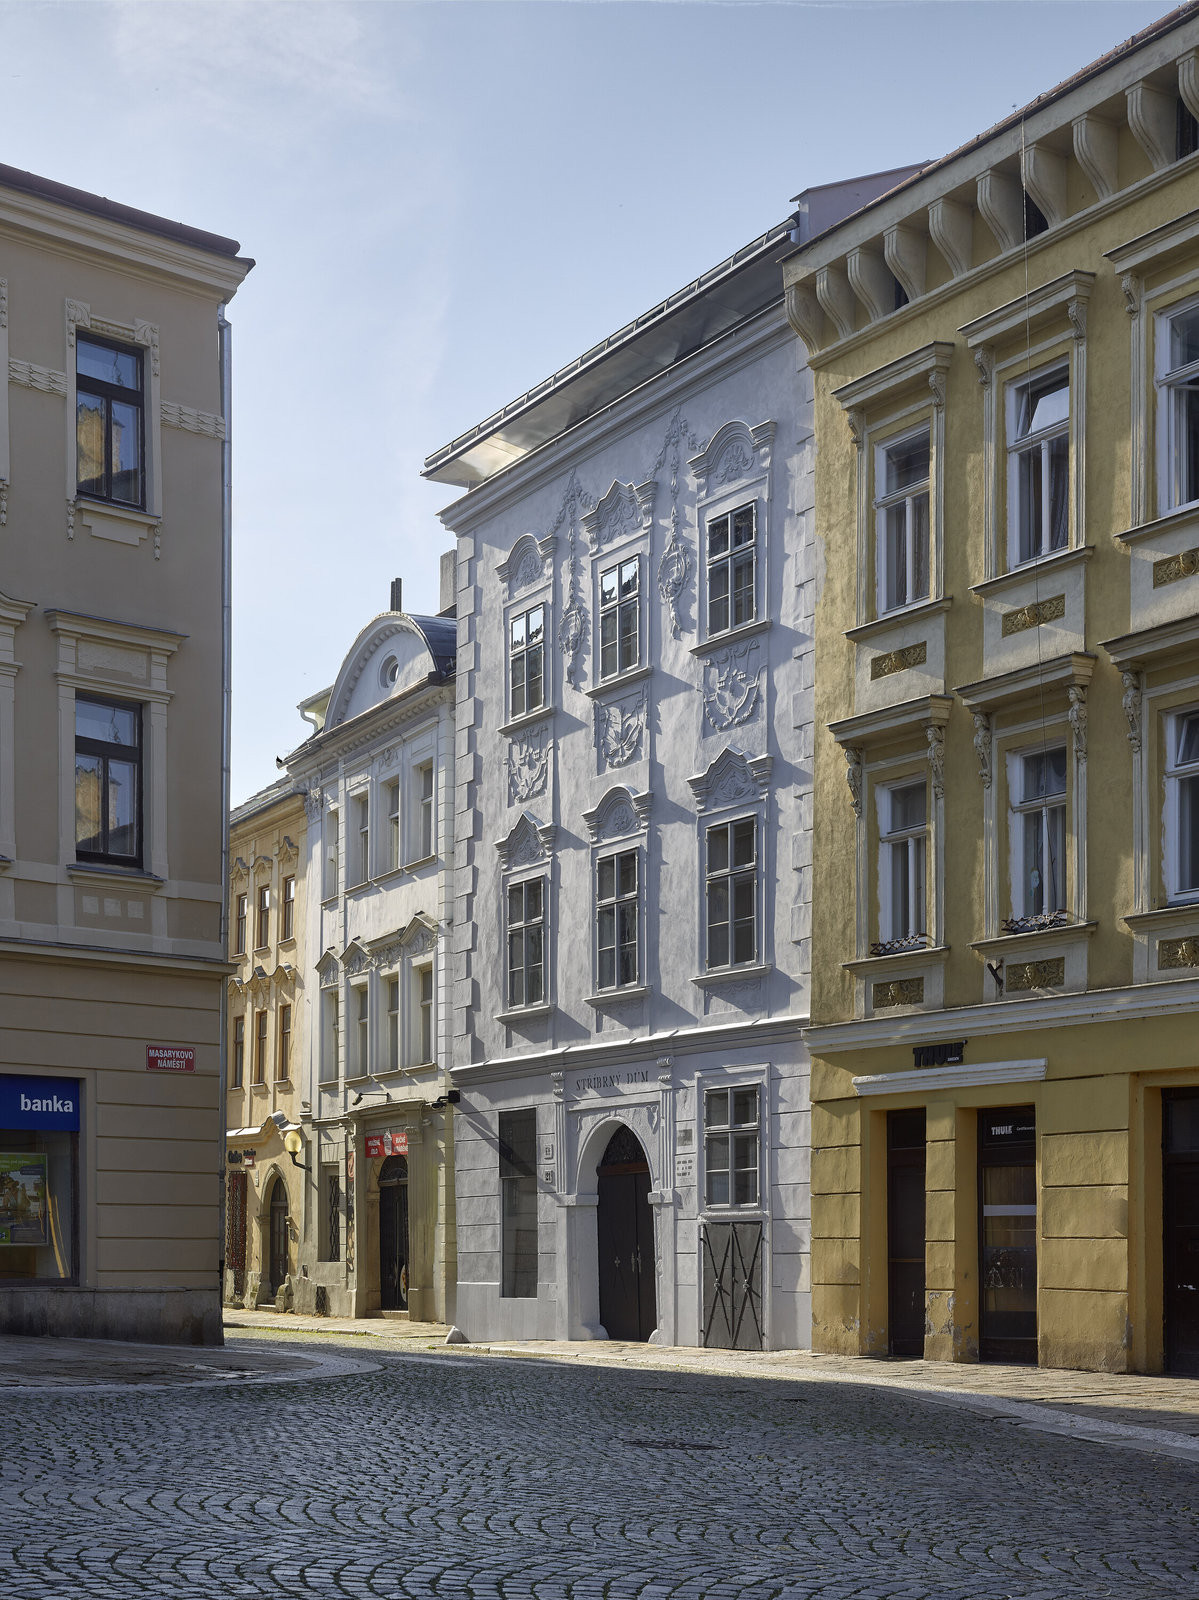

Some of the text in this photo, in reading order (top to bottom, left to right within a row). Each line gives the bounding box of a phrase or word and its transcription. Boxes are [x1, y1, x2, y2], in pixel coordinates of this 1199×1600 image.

[149, 1049, 194, 1060] MASARYKOVO
[913, 1042, 963, 1067] THULE
[157, 1058, 186, 1069] NÁMĚSTÍ
[576, 1067, 648, 1091] STŘÍBRNÝ DŮM
[20, 1093, 74, 1113] banka
[991, 1125, 1013, 1136] THULE
